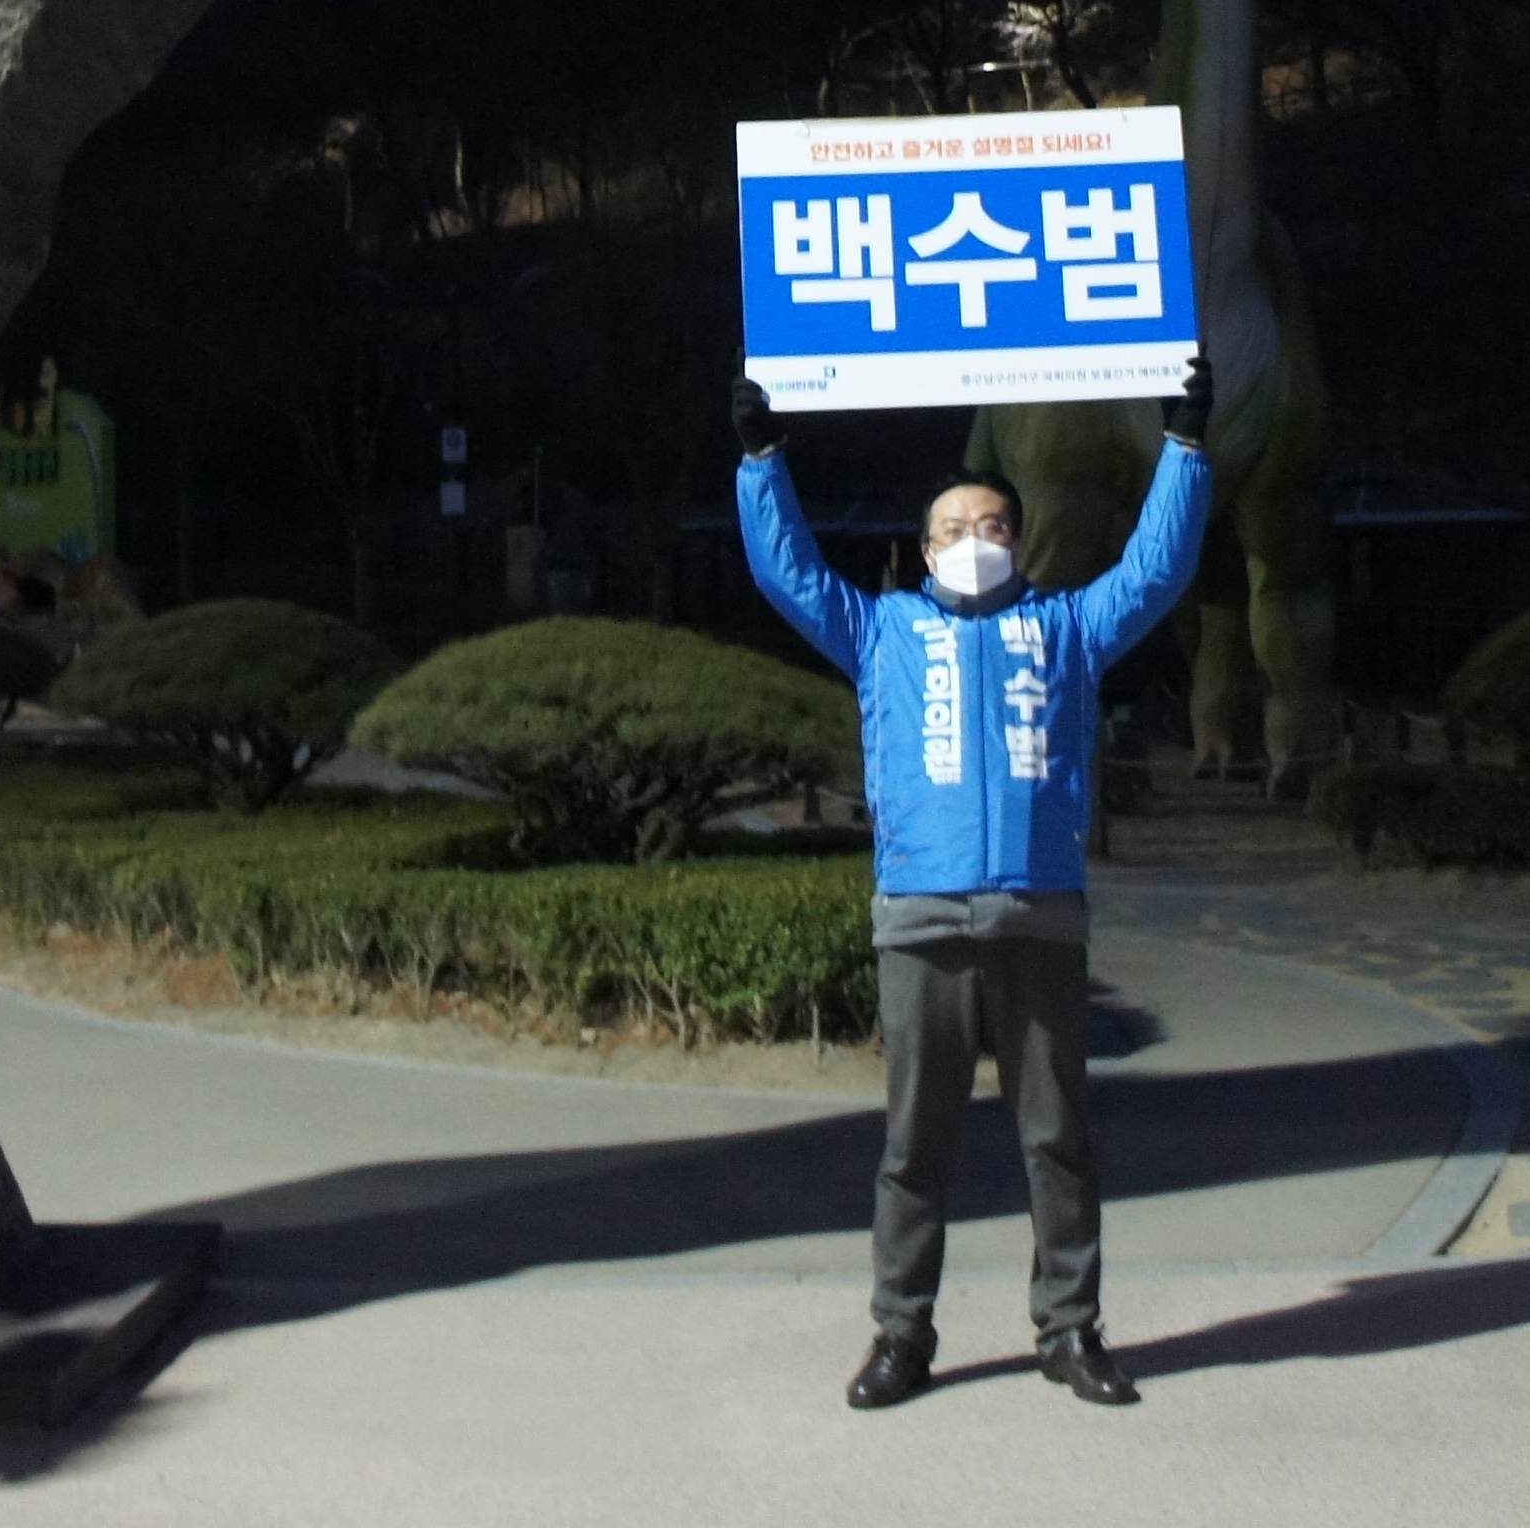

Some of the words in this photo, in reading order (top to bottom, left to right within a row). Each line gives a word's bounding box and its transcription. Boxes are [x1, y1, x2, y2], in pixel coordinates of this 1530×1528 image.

[810, 140, 894, 162] 안전하고
[902, 139, 964, 159] 즐거운
[972, 135, 1035, 157] 설명절
[1042, 132, 1112, 153] 되세요!
[772, 183, 1164, 332] 백수범
[998, 615, 1049, 780] 백수범
